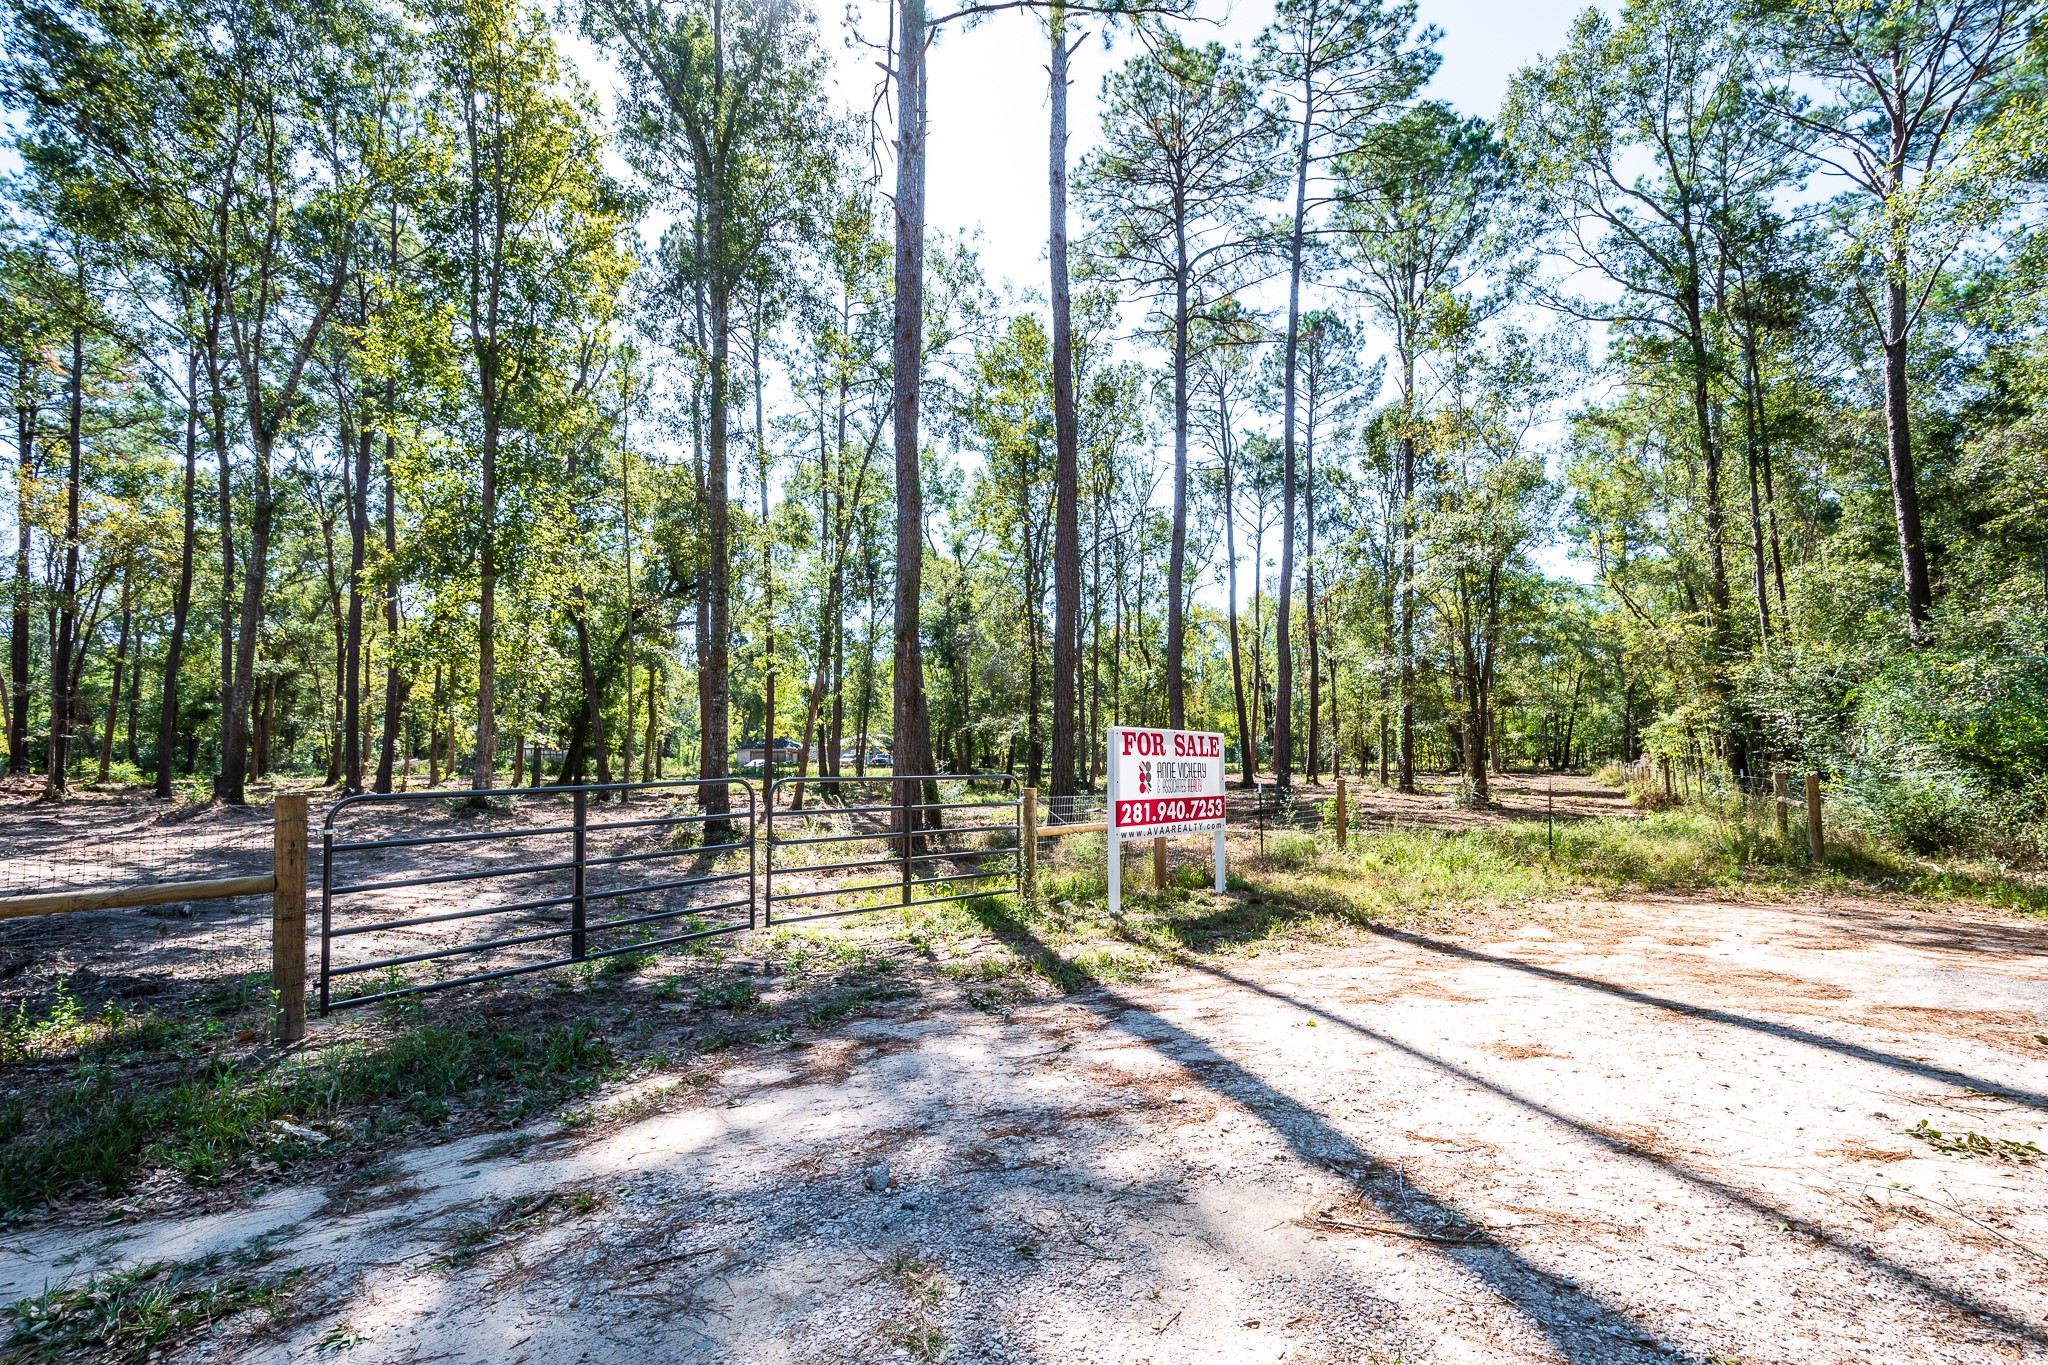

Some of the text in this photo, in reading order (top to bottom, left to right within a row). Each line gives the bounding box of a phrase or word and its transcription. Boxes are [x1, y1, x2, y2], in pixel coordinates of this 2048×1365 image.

[1122, 731, 1220, 757] FOR SALE
[1157, 762, 1206, 778] ANNE VICKERY
[1120, 798, 1223, 824] 281.940.7253
[1120, 822, 1222, 839] www.AVAAREALTY.com
